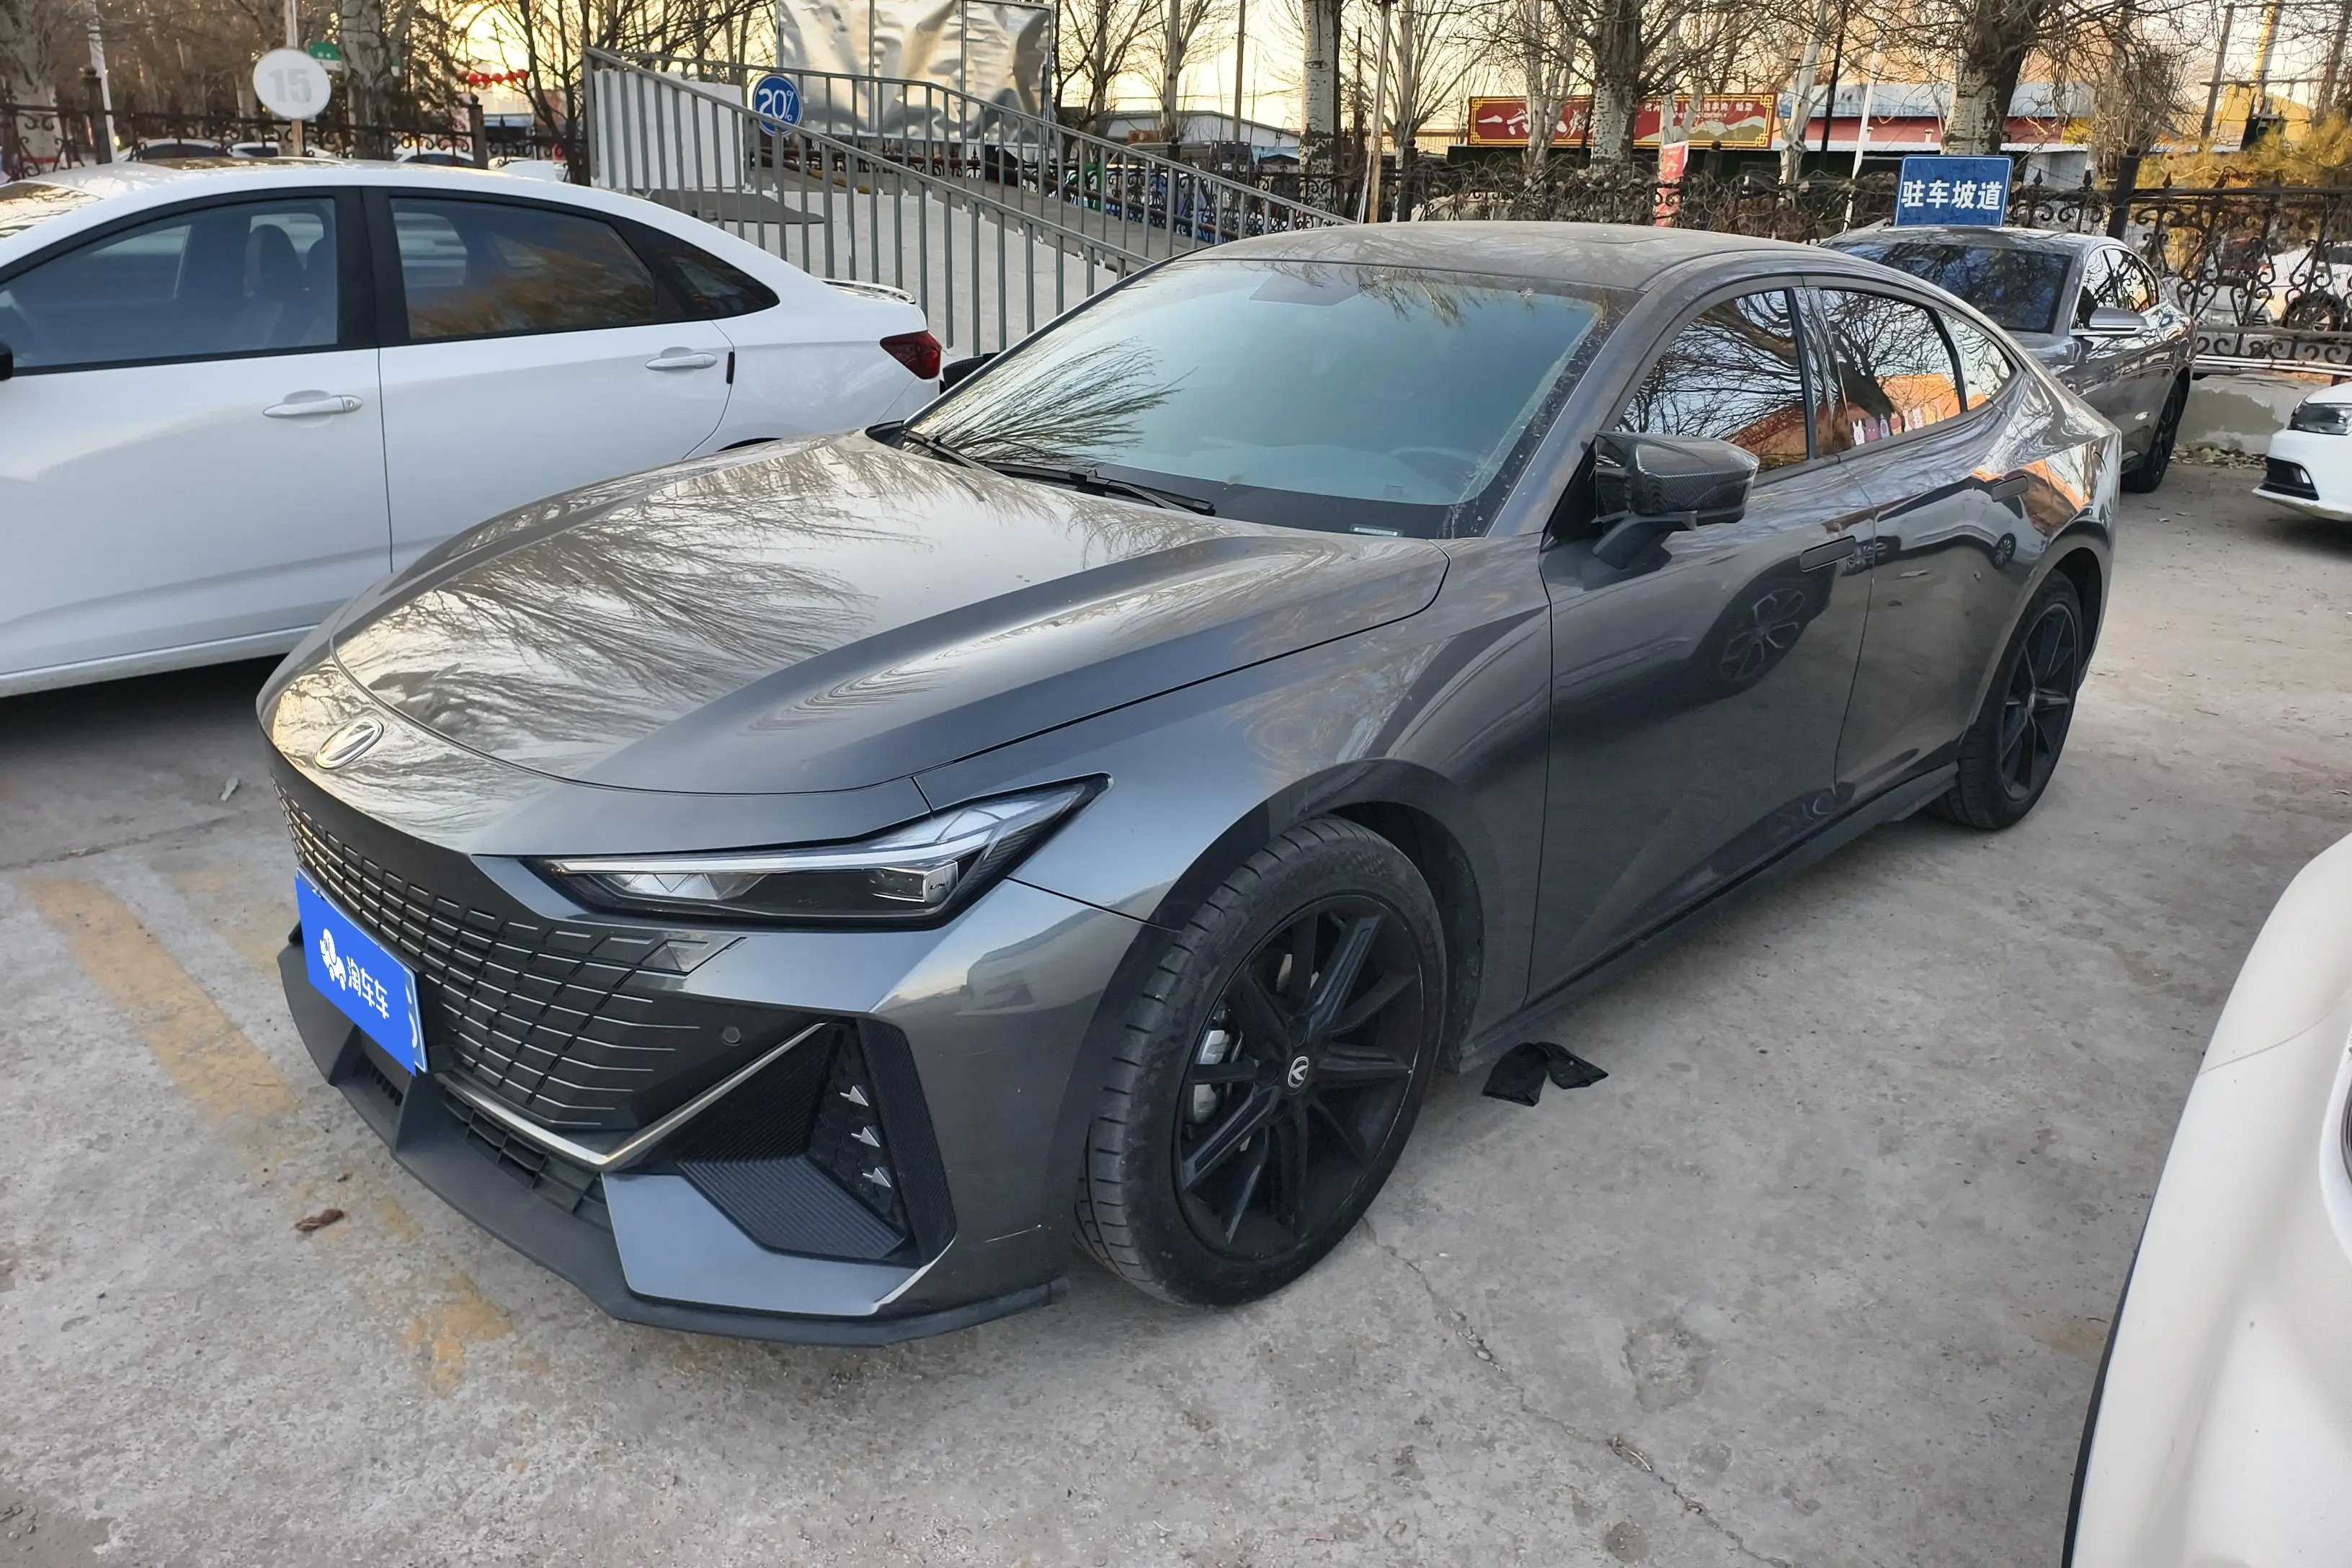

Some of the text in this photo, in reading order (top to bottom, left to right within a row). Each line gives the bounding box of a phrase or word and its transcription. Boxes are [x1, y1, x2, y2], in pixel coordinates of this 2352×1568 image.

[267, 68, 312, 103] 15
[758, 88, 794, 121] 20%
[1901, 179, 2003, 210] 驻车坡道
